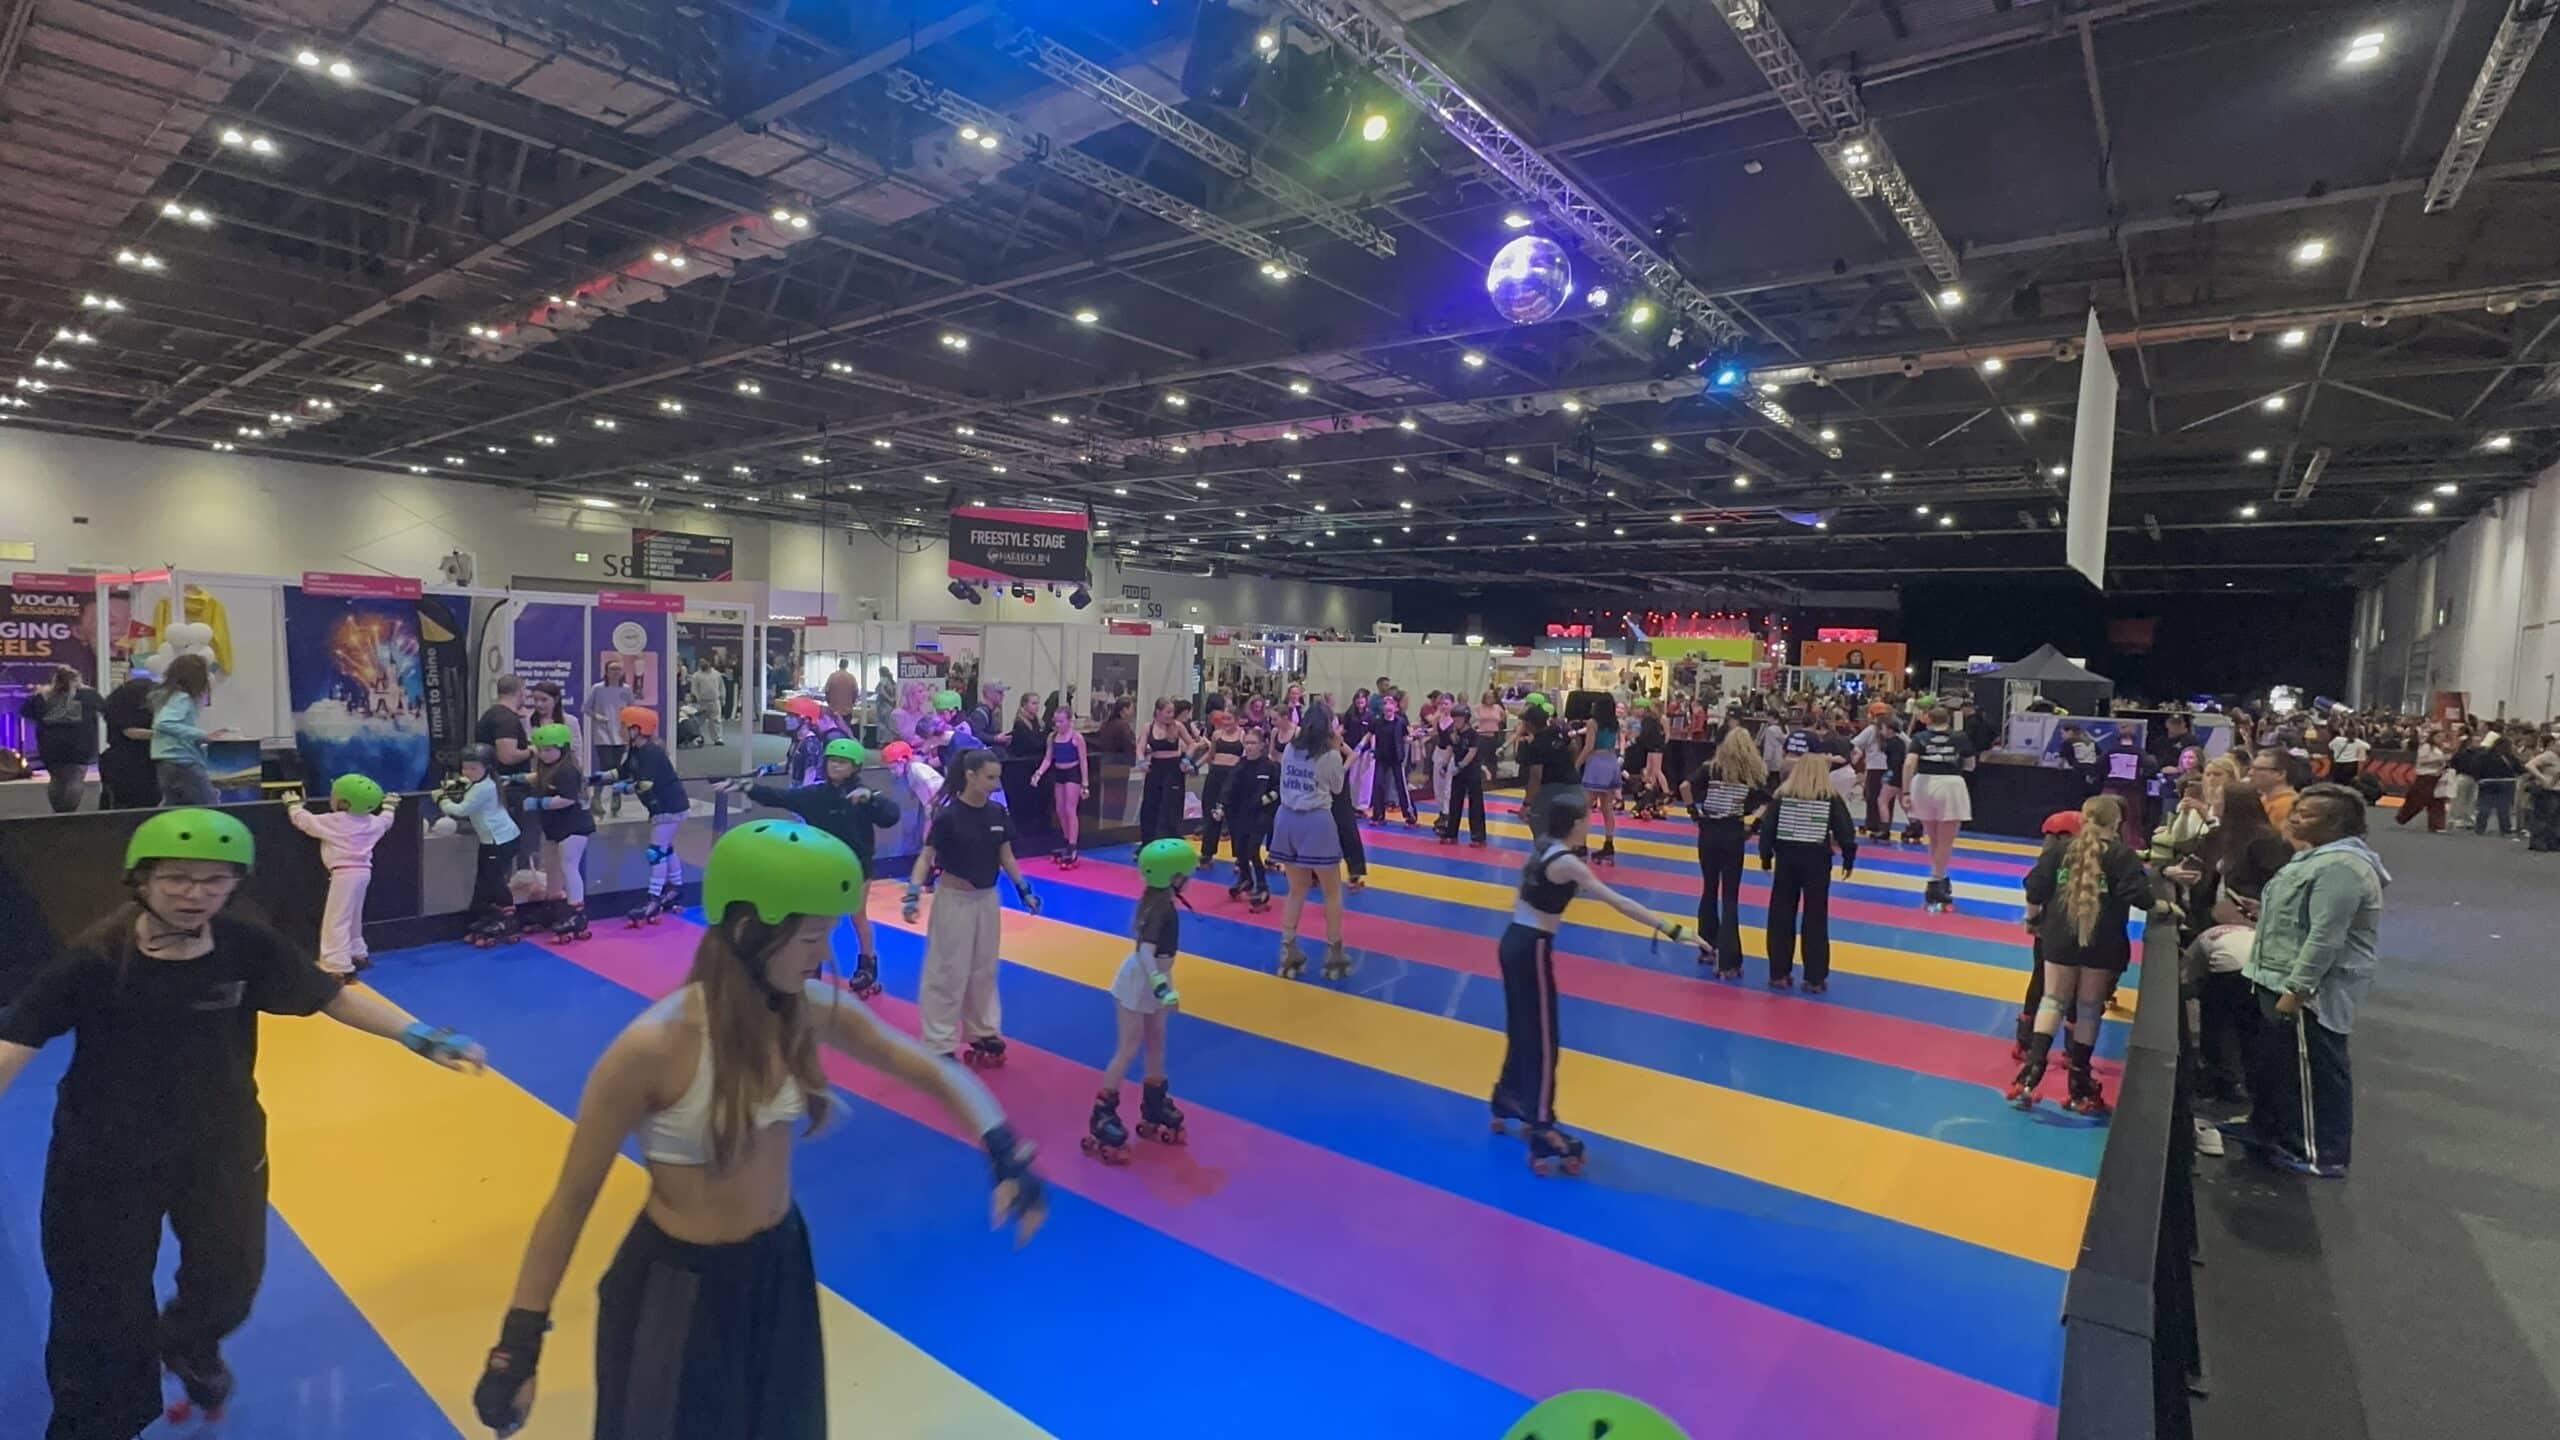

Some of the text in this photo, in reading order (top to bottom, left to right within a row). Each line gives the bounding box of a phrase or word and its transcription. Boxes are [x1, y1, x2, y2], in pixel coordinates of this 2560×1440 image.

[970, 529, 1066, 549] FREESTYLE STAGE
[11, 593, 80, 607] VOCAL
[1146, 602, 1163, 618] S9
[0, 639, 52, 656] ELS
[425, 647, 443, 738] Time to Shine
[1286, 764, 1315, 779] Skate
